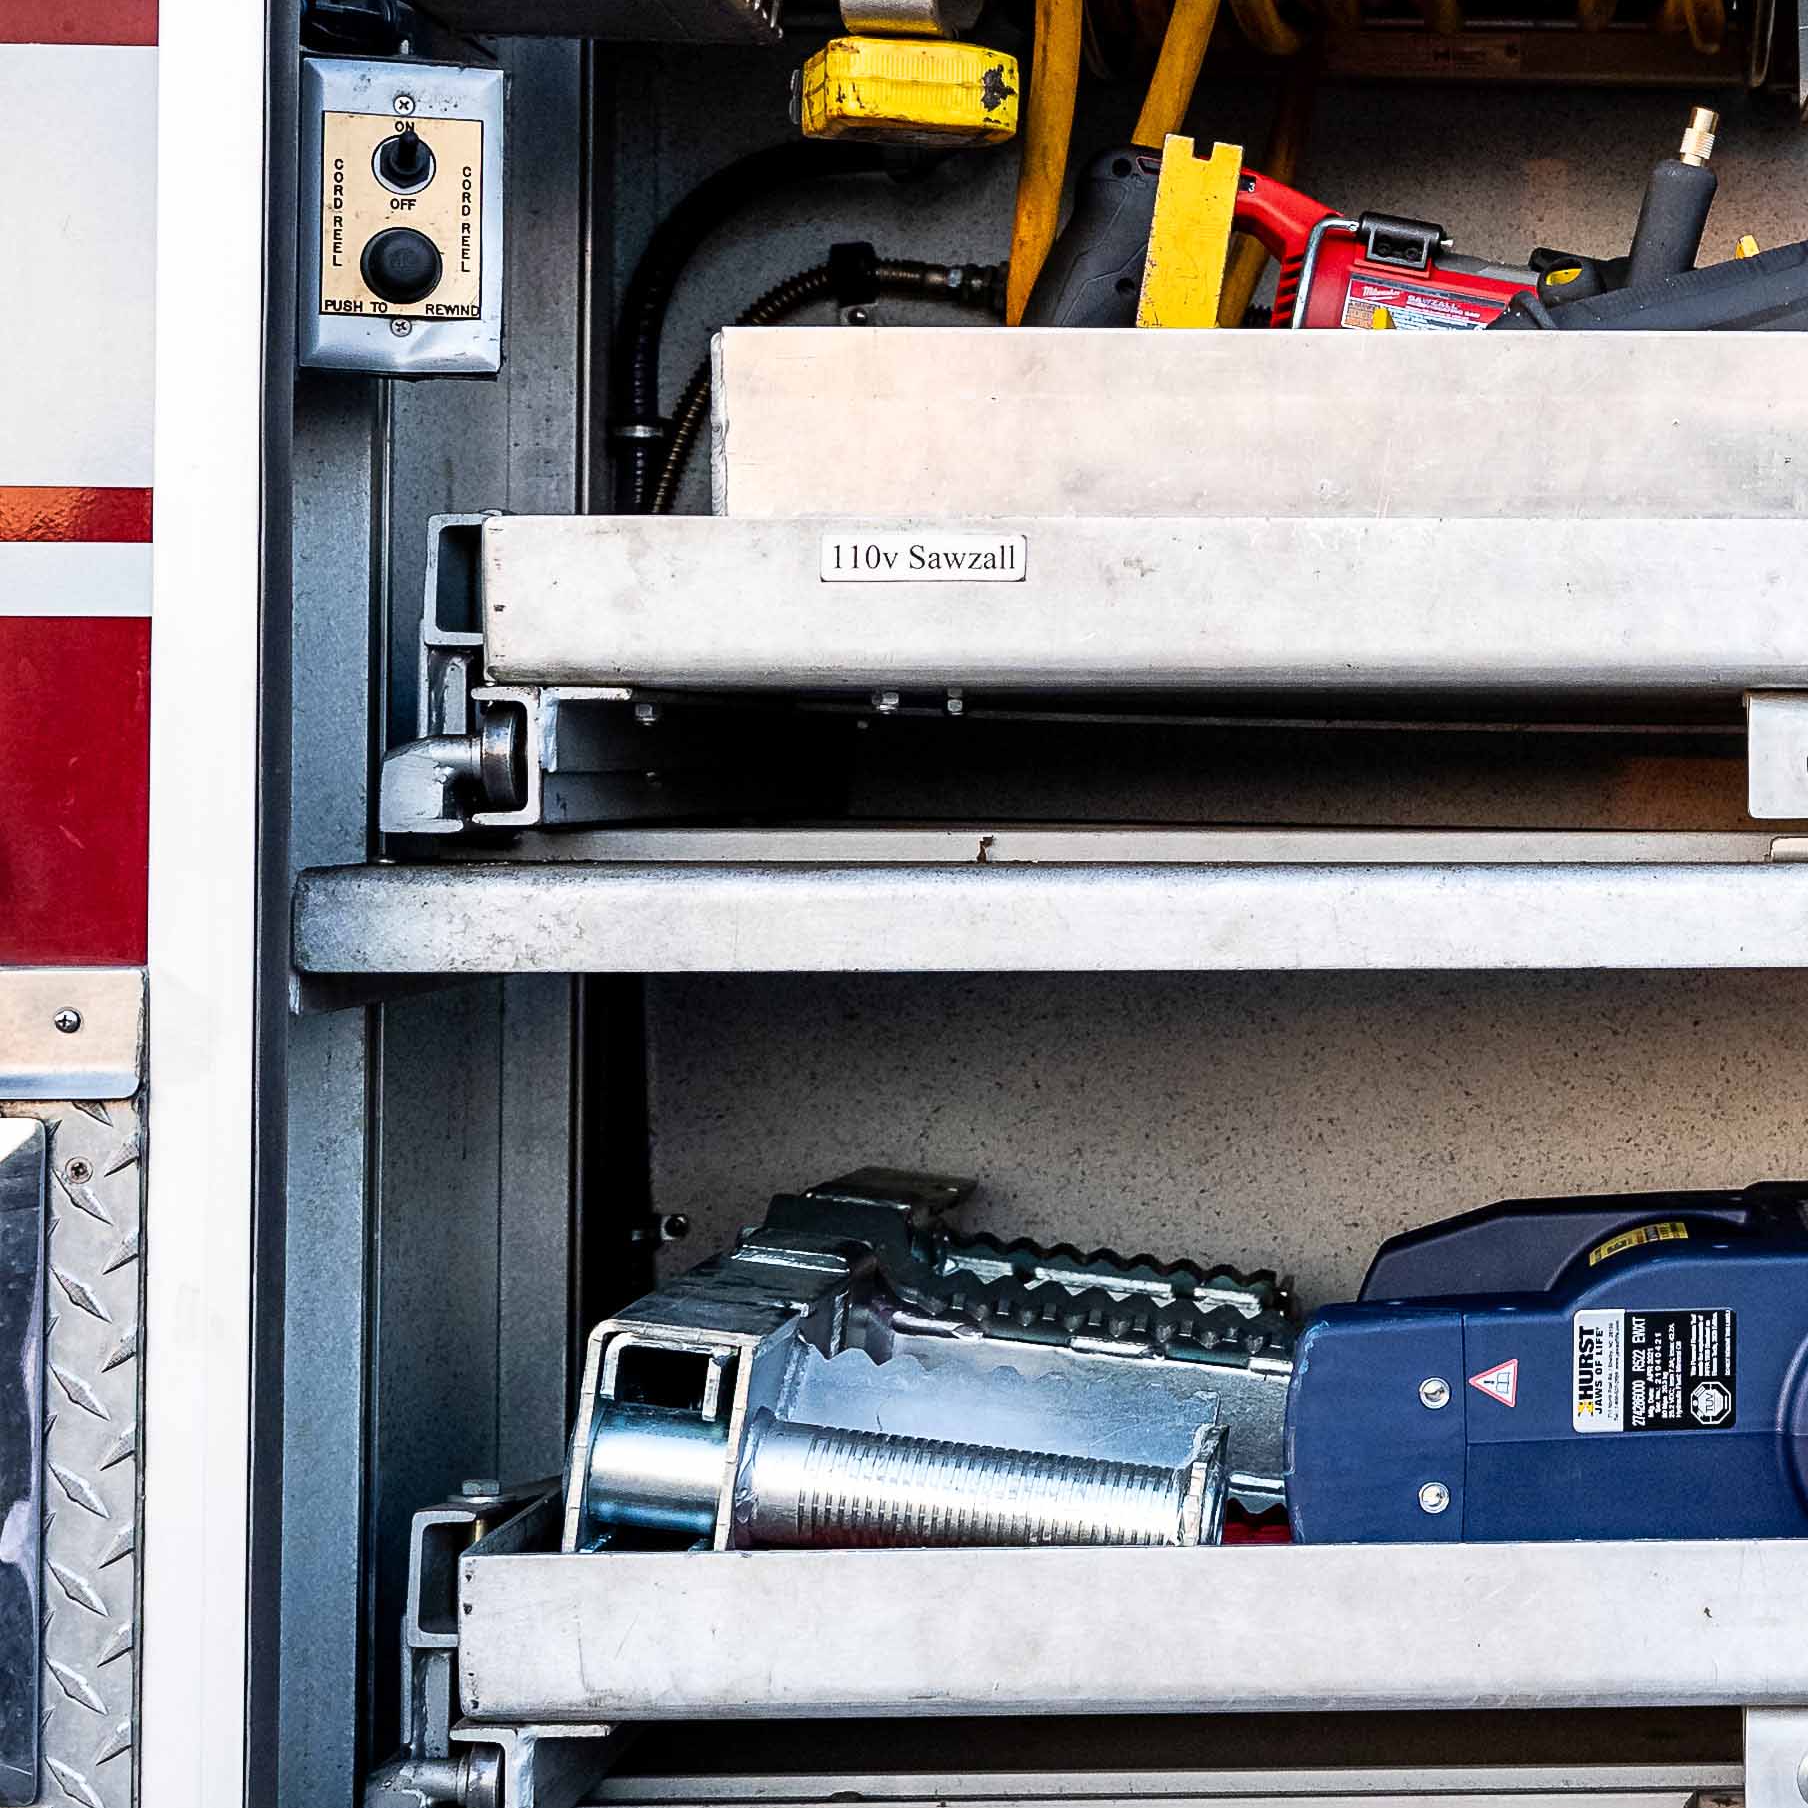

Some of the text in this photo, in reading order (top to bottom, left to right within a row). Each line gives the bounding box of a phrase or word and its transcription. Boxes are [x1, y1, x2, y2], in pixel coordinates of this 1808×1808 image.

[395, 121, 416, 132] ON
[1248, 182, 1256, 193] 3
[333, 158, 345, 268] CORD REEL
[390, 199, 417, 211] OFF
[461, 167, 473, 272] CORD REEL
[325, 300, 480, 316] PUSH TO REWIND
[833, 544, 1015, 569] 110v Sawzall
[1632, 1316, 1645, 1343] EWXT
[1579, 1326, 1594, 1400] HURST
[1595, 1361, 1602, 1375] OF
[1632, 1350, 1645, 1371] R522
